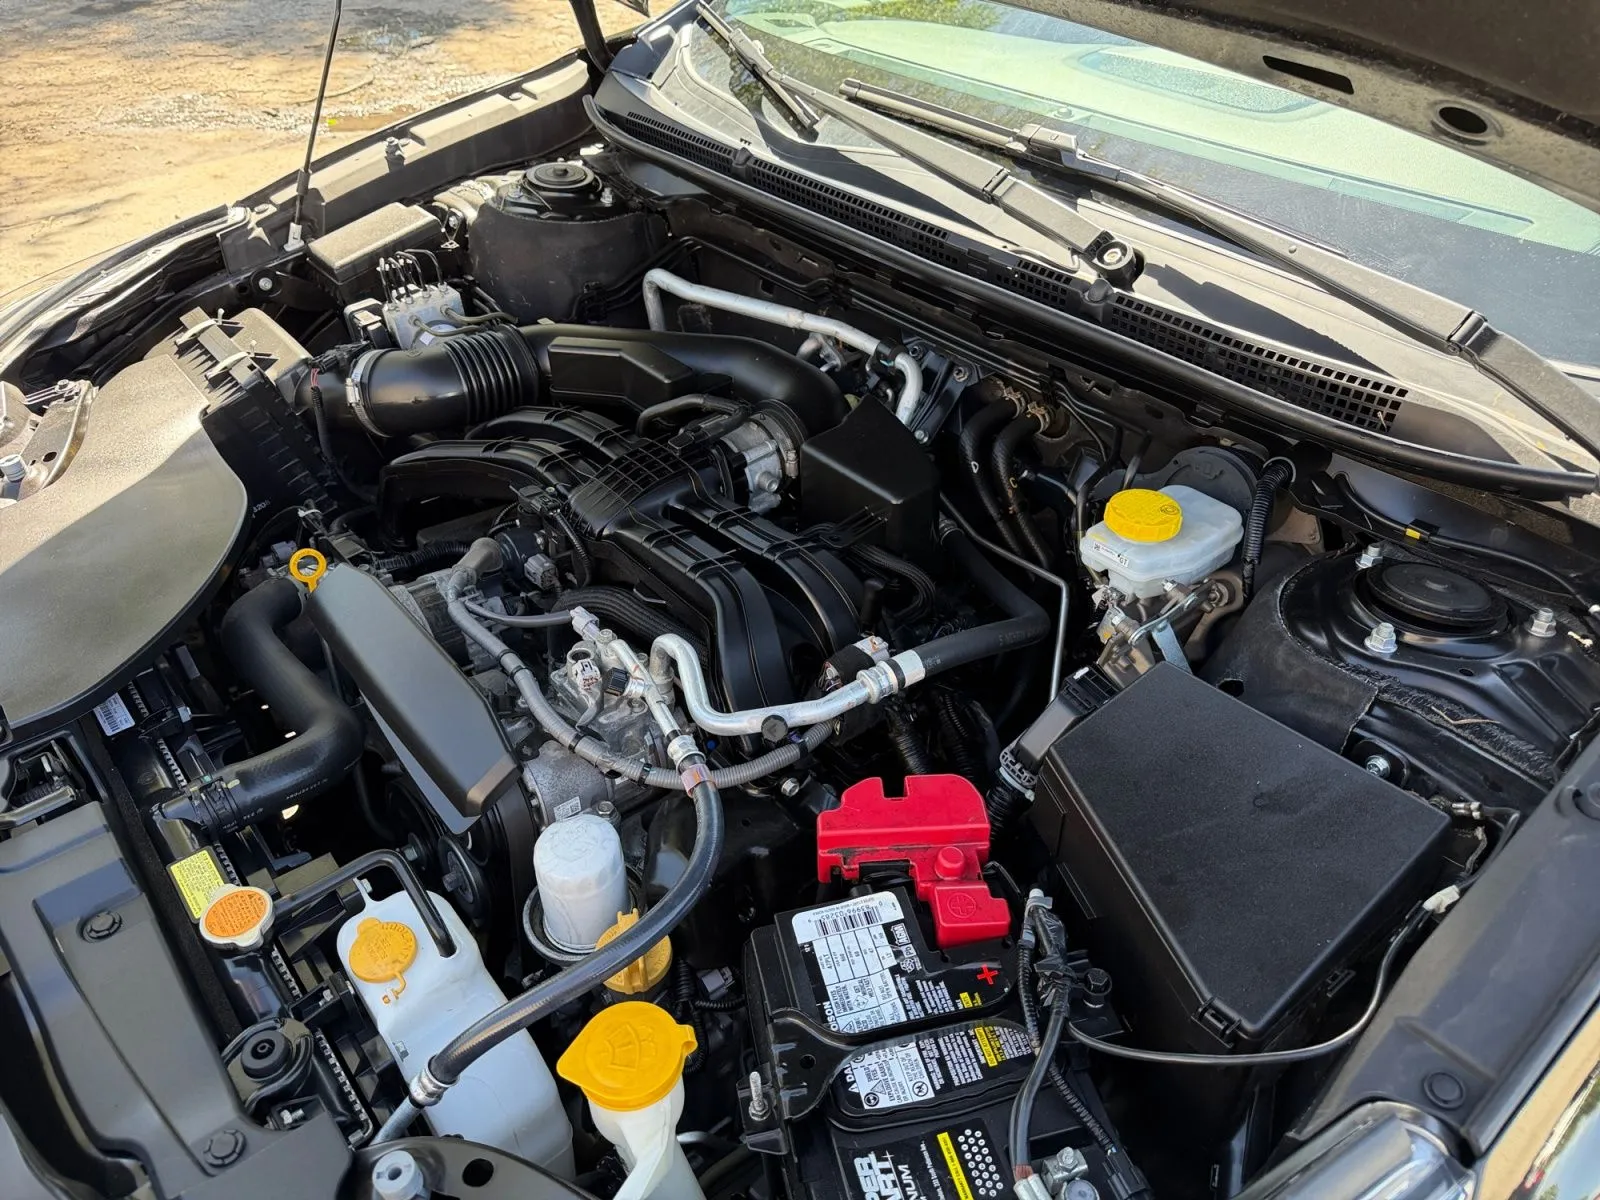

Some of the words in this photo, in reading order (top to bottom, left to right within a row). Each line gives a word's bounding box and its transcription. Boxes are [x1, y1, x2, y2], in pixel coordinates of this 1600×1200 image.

[893, 924, 908, 944] AGM
[903, 945, 913, 956] Pb
[822, 999, 839, 1032] OISON
